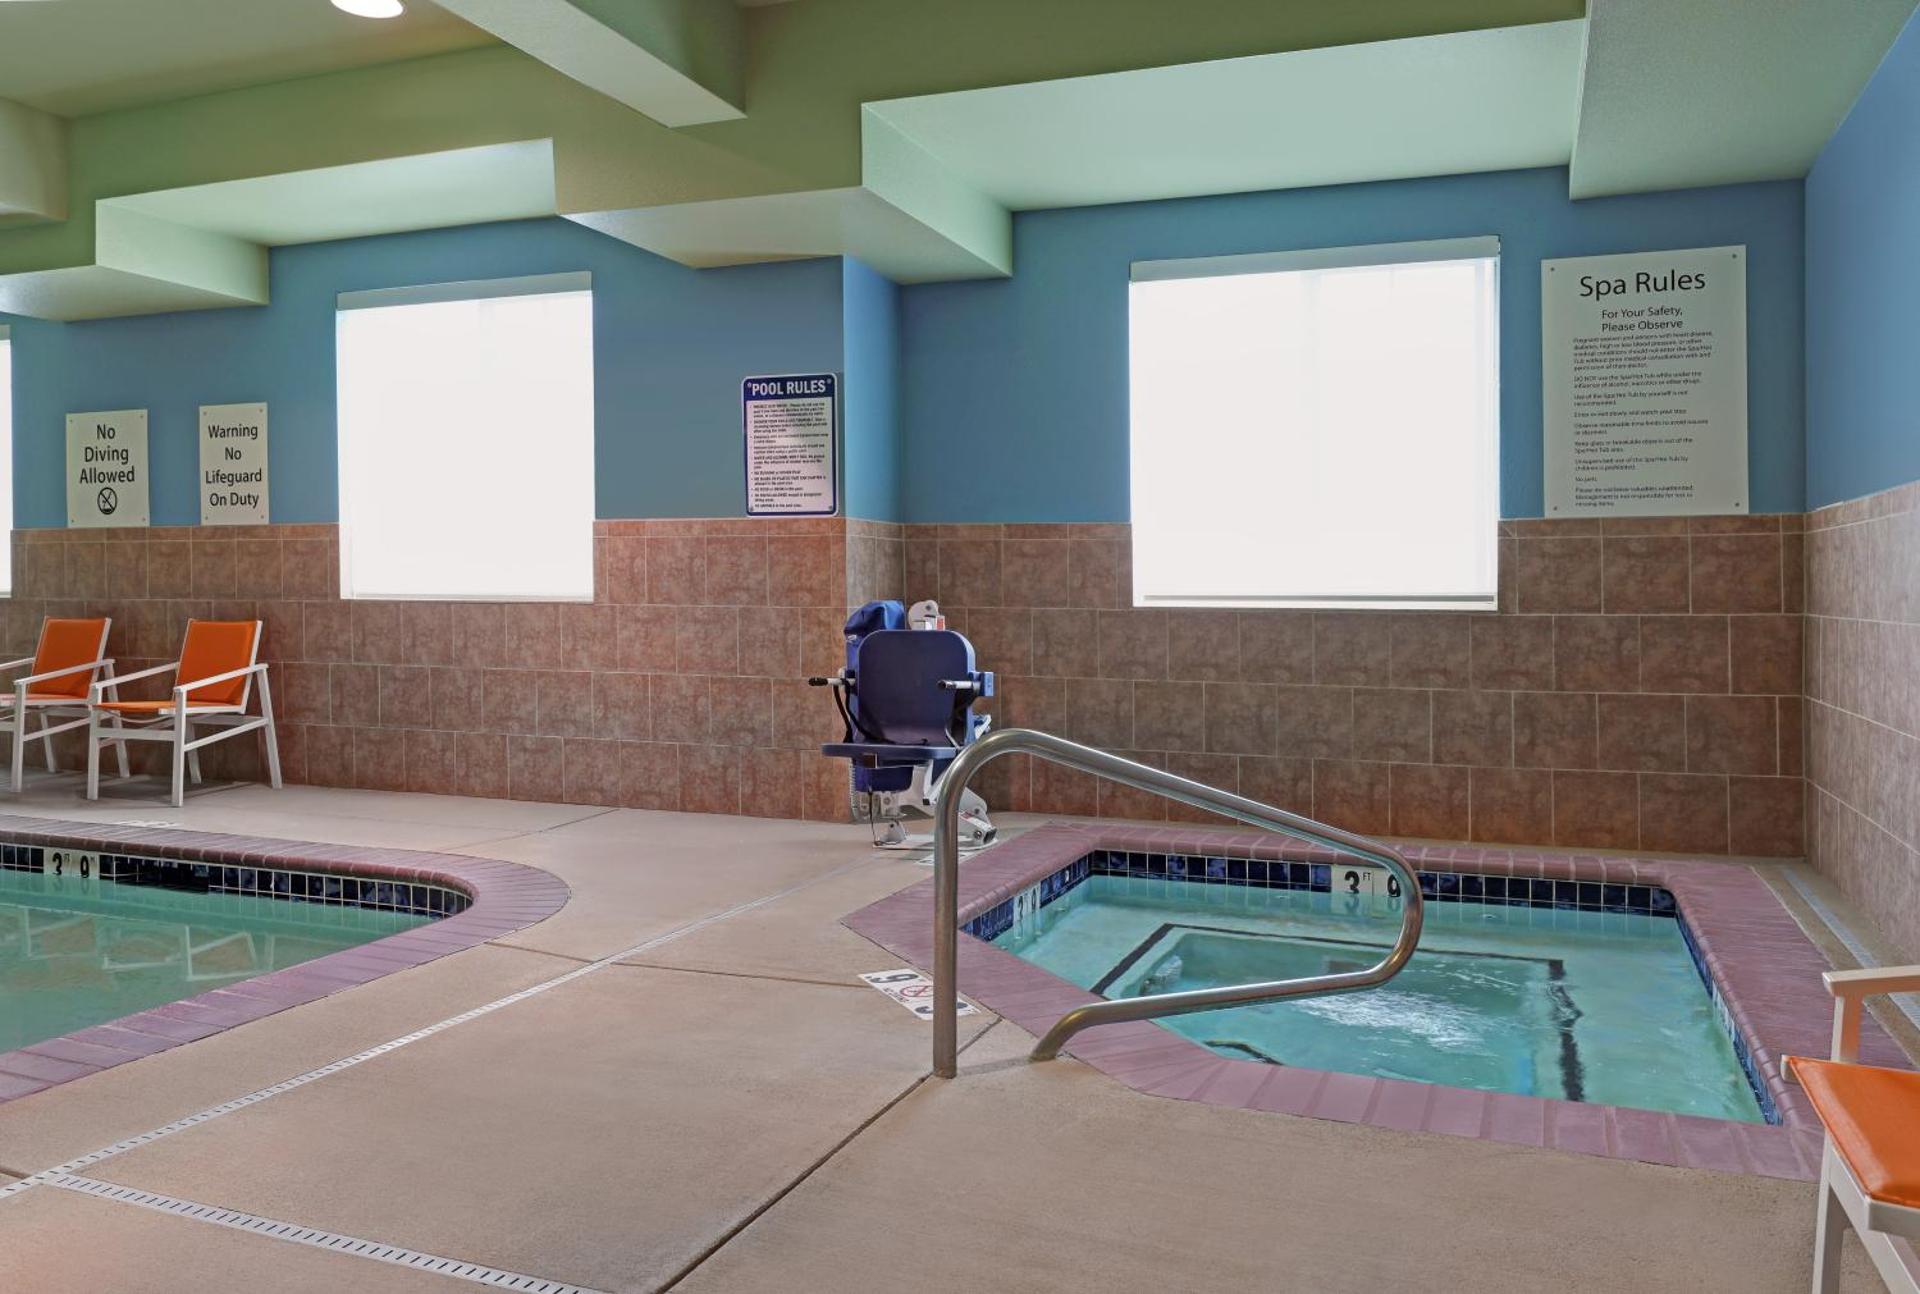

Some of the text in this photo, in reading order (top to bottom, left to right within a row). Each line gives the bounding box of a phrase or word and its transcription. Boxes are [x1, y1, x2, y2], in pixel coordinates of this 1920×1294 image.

[1580, 269, 1706, 301] Spa Rules
[1602, 305, 1683, 319] For Your Safety,
[1602, 320, 1683, 333] Please Observe
[752, 380, 826, 396] POOL RULES
[97, 424, 116, 440] No
[208, 424, 258, 440] Warning
[84, 445, 128, 465] Diving
[225, 447, 242, 460] No
[80, 465, 135, 484] Allowed
[205, 468, 262, 487] Lifeguard
[209, 492, 259, 509] On Duty
[1345, 871, 1360, 894] 3
[1363, 872, 1371, 880] FT
